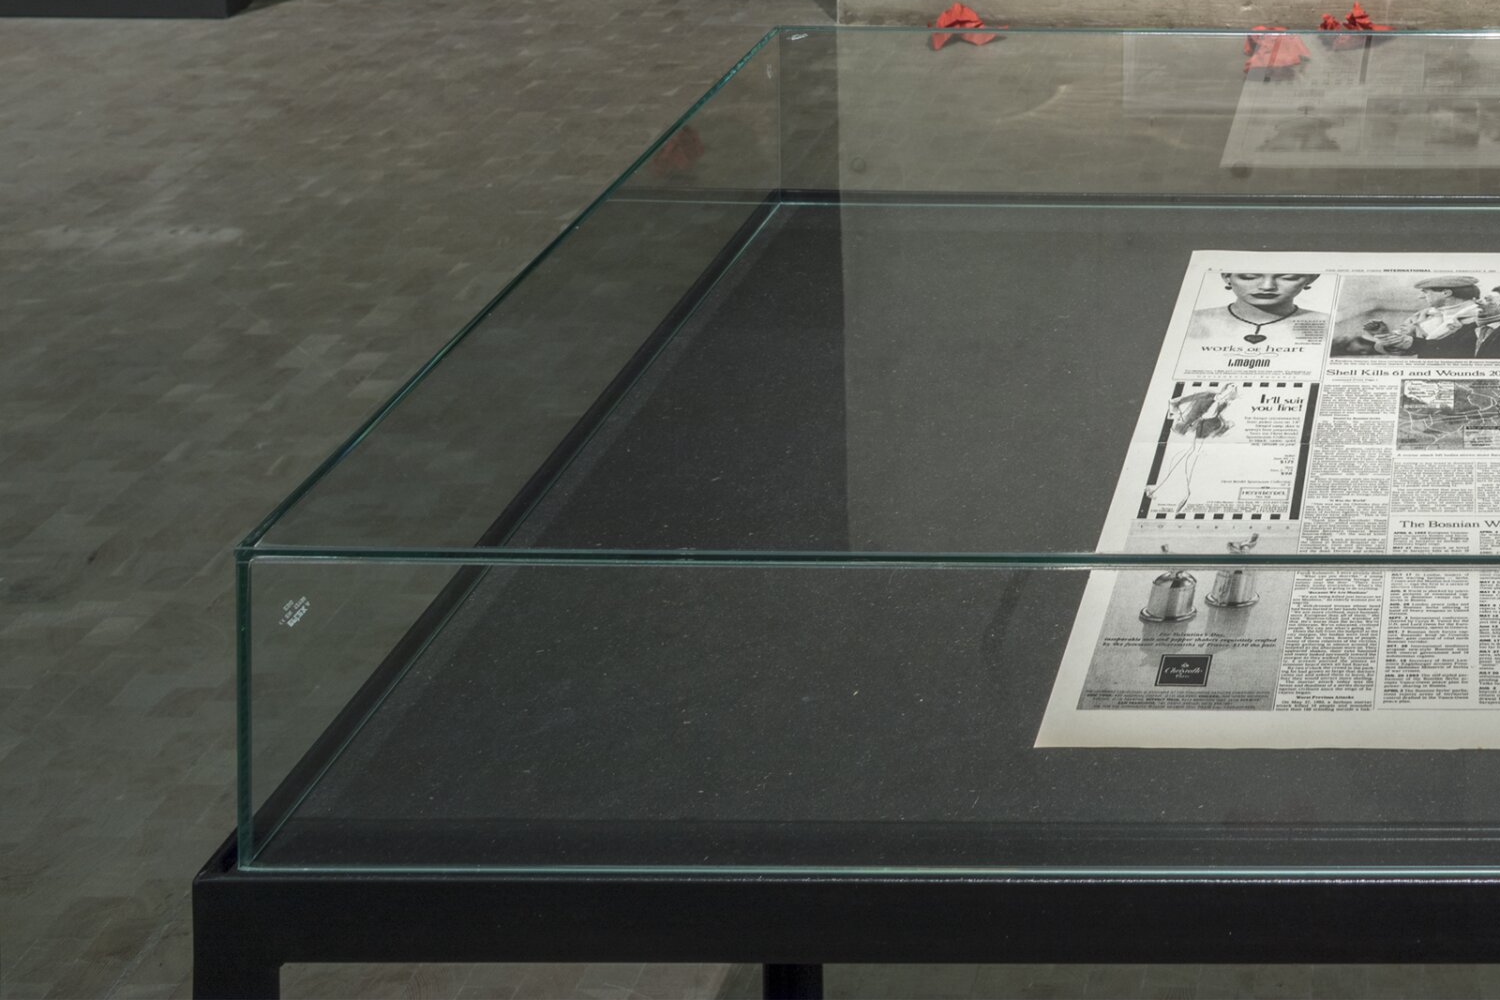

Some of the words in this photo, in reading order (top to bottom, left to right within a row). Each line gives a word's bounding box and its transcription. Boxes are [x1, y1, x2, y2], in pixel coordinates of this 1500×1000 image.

[1251, 405, 1273, 413] you
[1399, 520, 1425, 528] The
[1428, 520, 1480, 528] Bosnian
